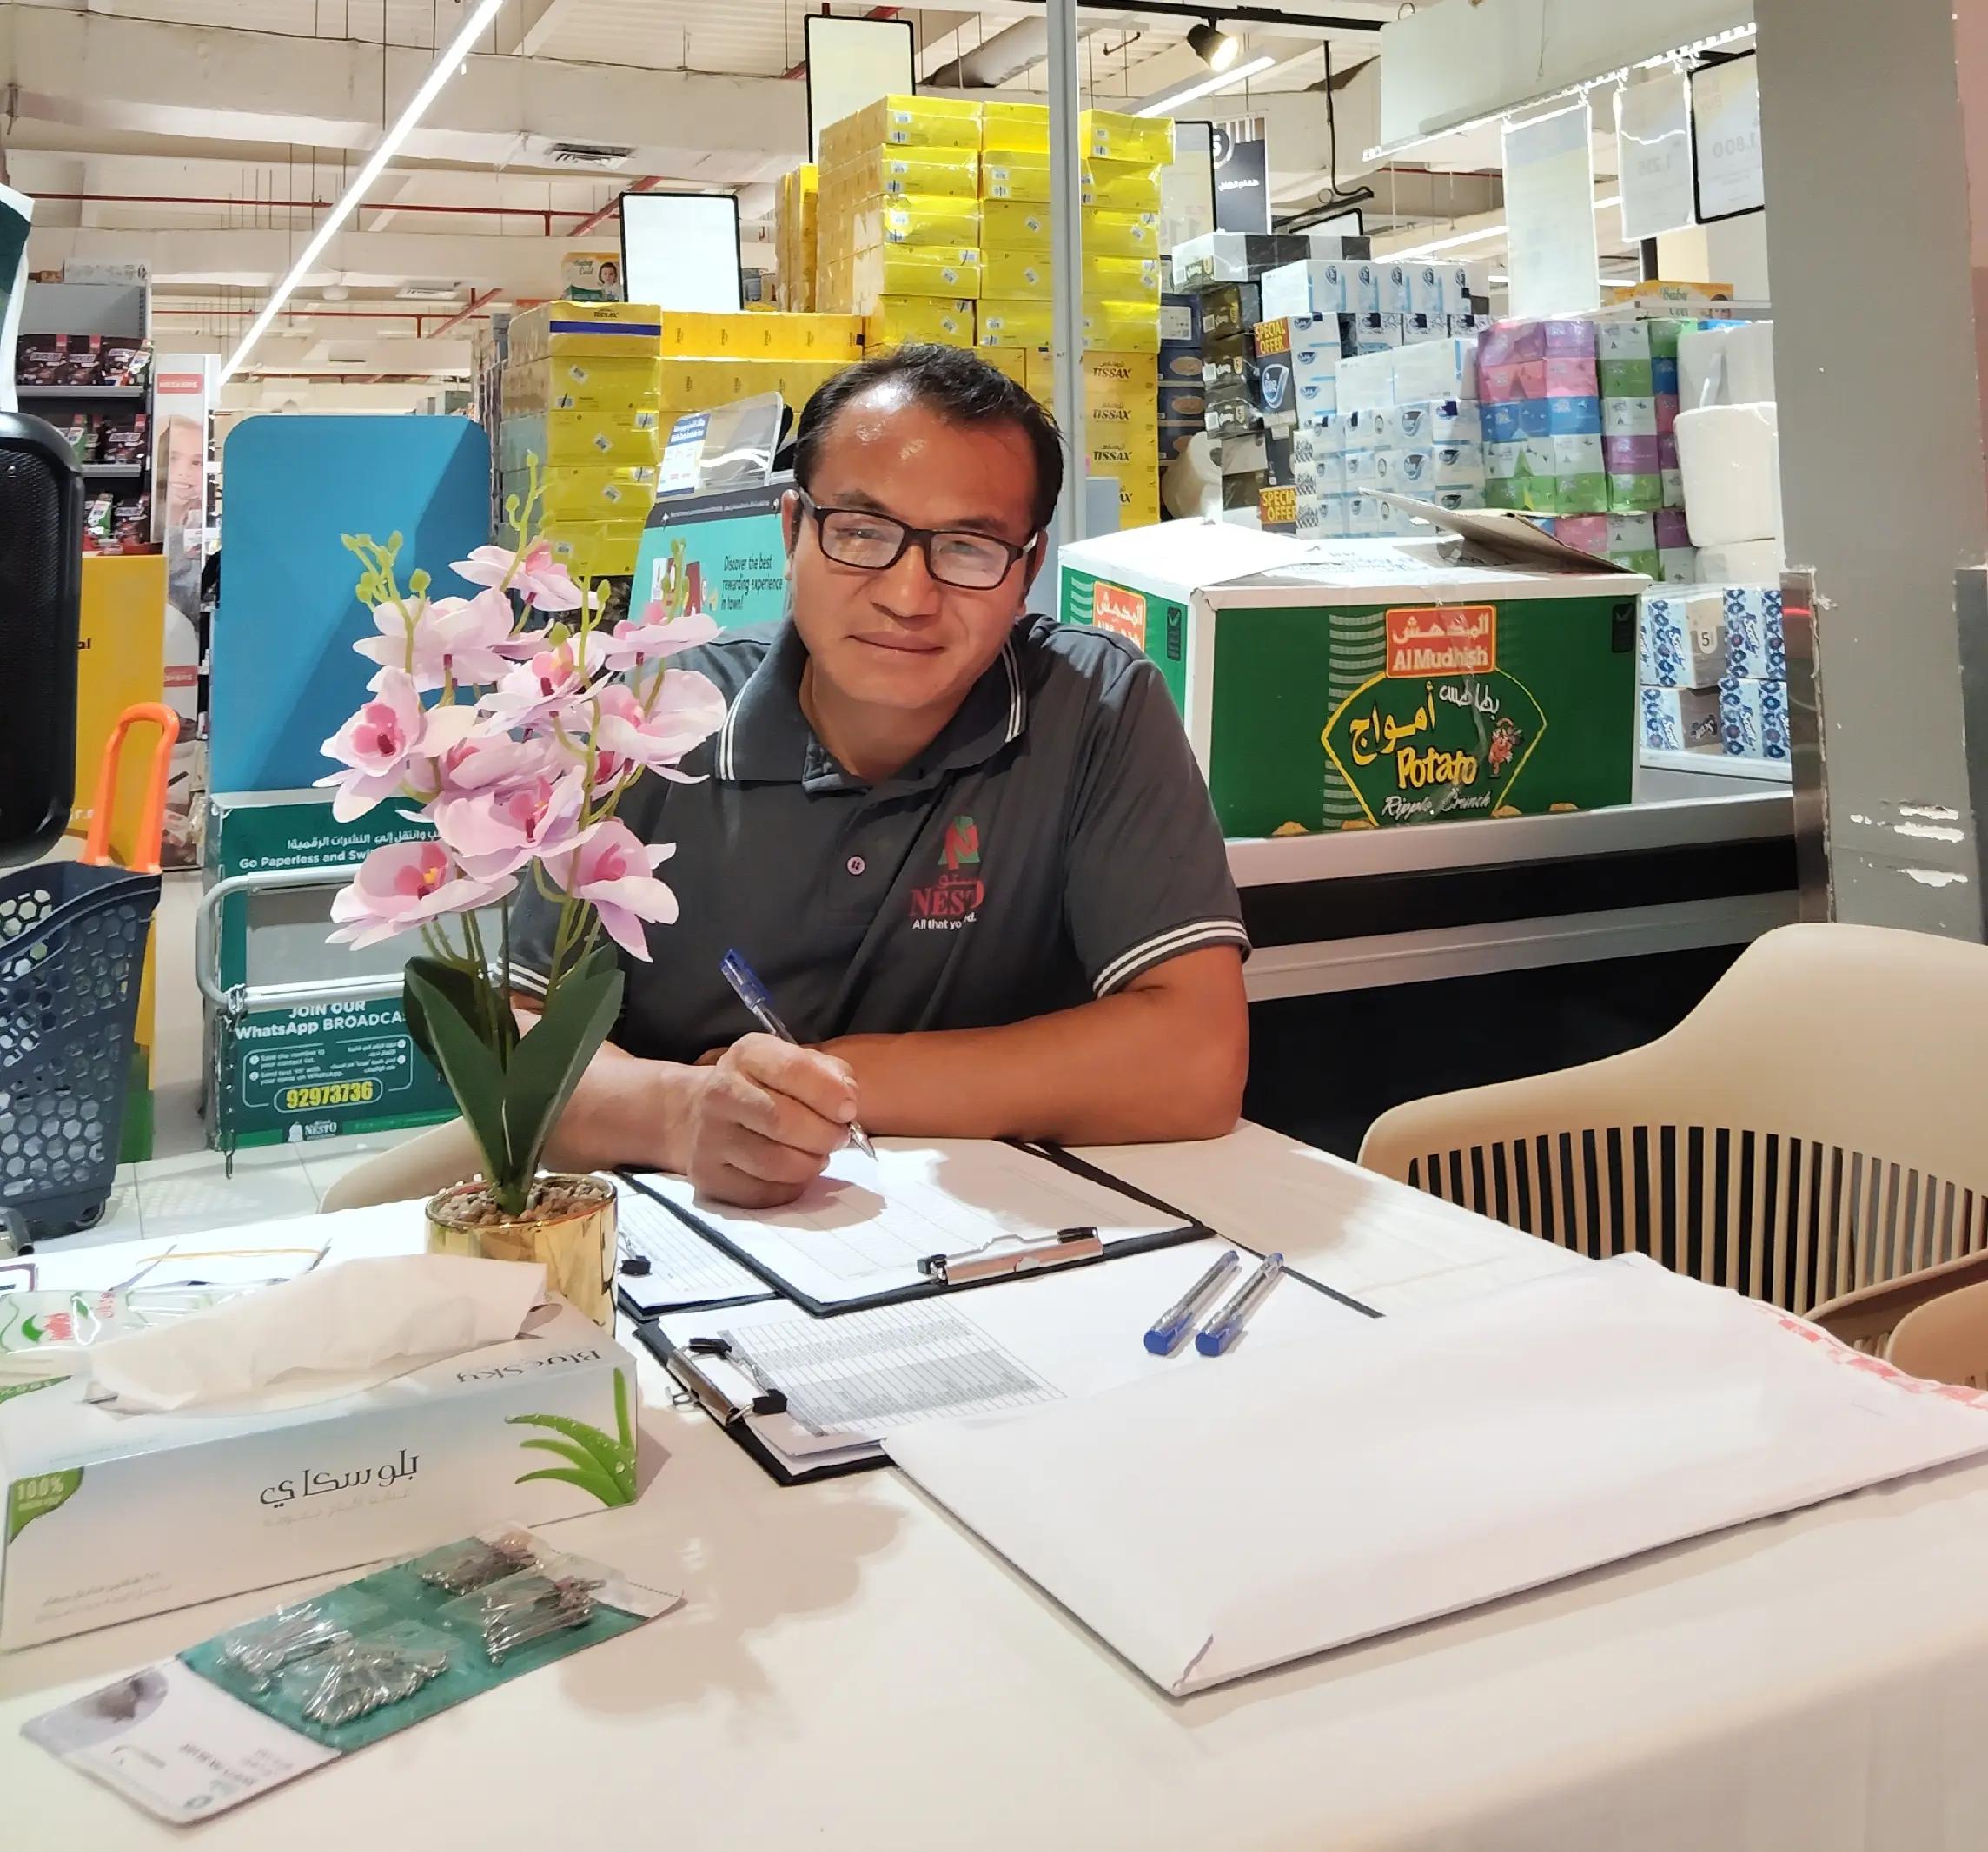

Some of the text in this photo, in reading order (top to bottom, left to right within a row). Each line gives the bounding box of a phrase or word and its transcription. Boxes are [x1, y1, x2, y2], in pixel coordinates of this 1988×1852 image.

[1255, 320, 1286, 341] SPECIAL
[1260, 336, 1285, 354] OFFER
[1093, 451, 1133, 461] TISSAX
[1262, 489, 1296, 506] SPECIA
[1392, 645, 1488, 671] Al Mudhish
[1439, 683, 1501, 721] بطاطس
[1350, 681, 1435, 765] أمواج
[1397, 746, 1477, 790] Potato
[239, 849, 372, 869] Go Paperless and Swi
[912, 919, 962, 930] All that yo
[289, 1001, 366, 1019] JOIN OUR
[235, 1010, 406, 1040] WhatsApp BROADCA
[286, 1081, 374, 1108] 92973736
[17, 1475, 64, 1501] 100%
[260, 1468, 372, 1509] سكاي
